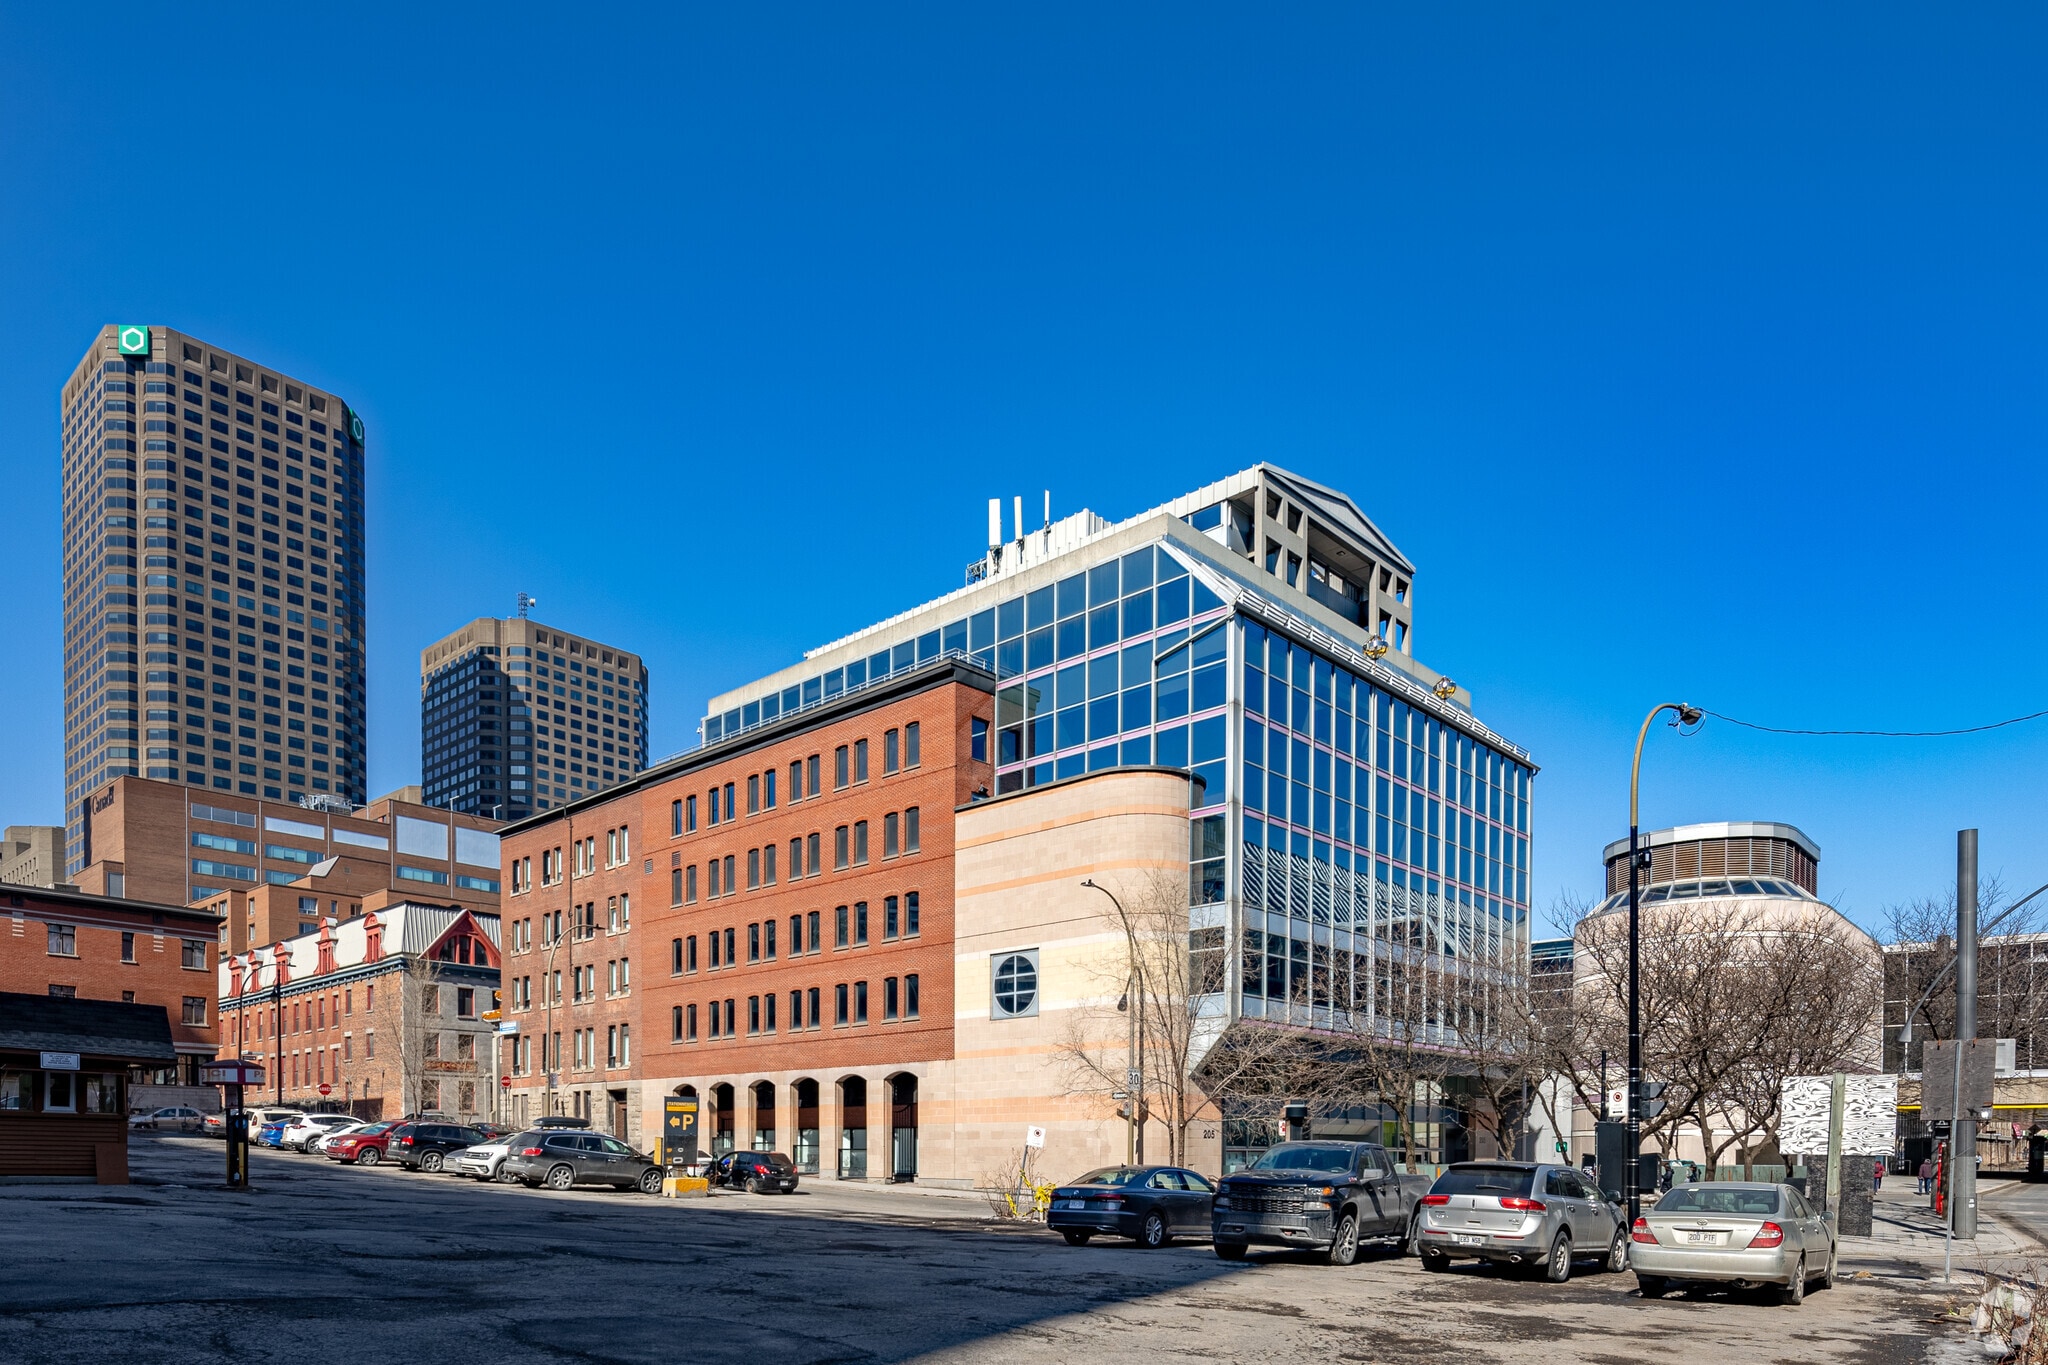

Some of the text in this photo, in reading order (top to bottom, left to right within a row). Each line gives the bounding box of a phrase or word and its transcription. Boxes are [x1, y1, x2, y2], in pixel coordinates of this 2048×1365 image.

[92, 792, 114, 815] Canada
[1129, 1073, 1139, 1085] 30
[682, 1114, 694, 1131] P
[1203, 1130, 1215, 1139] 205
